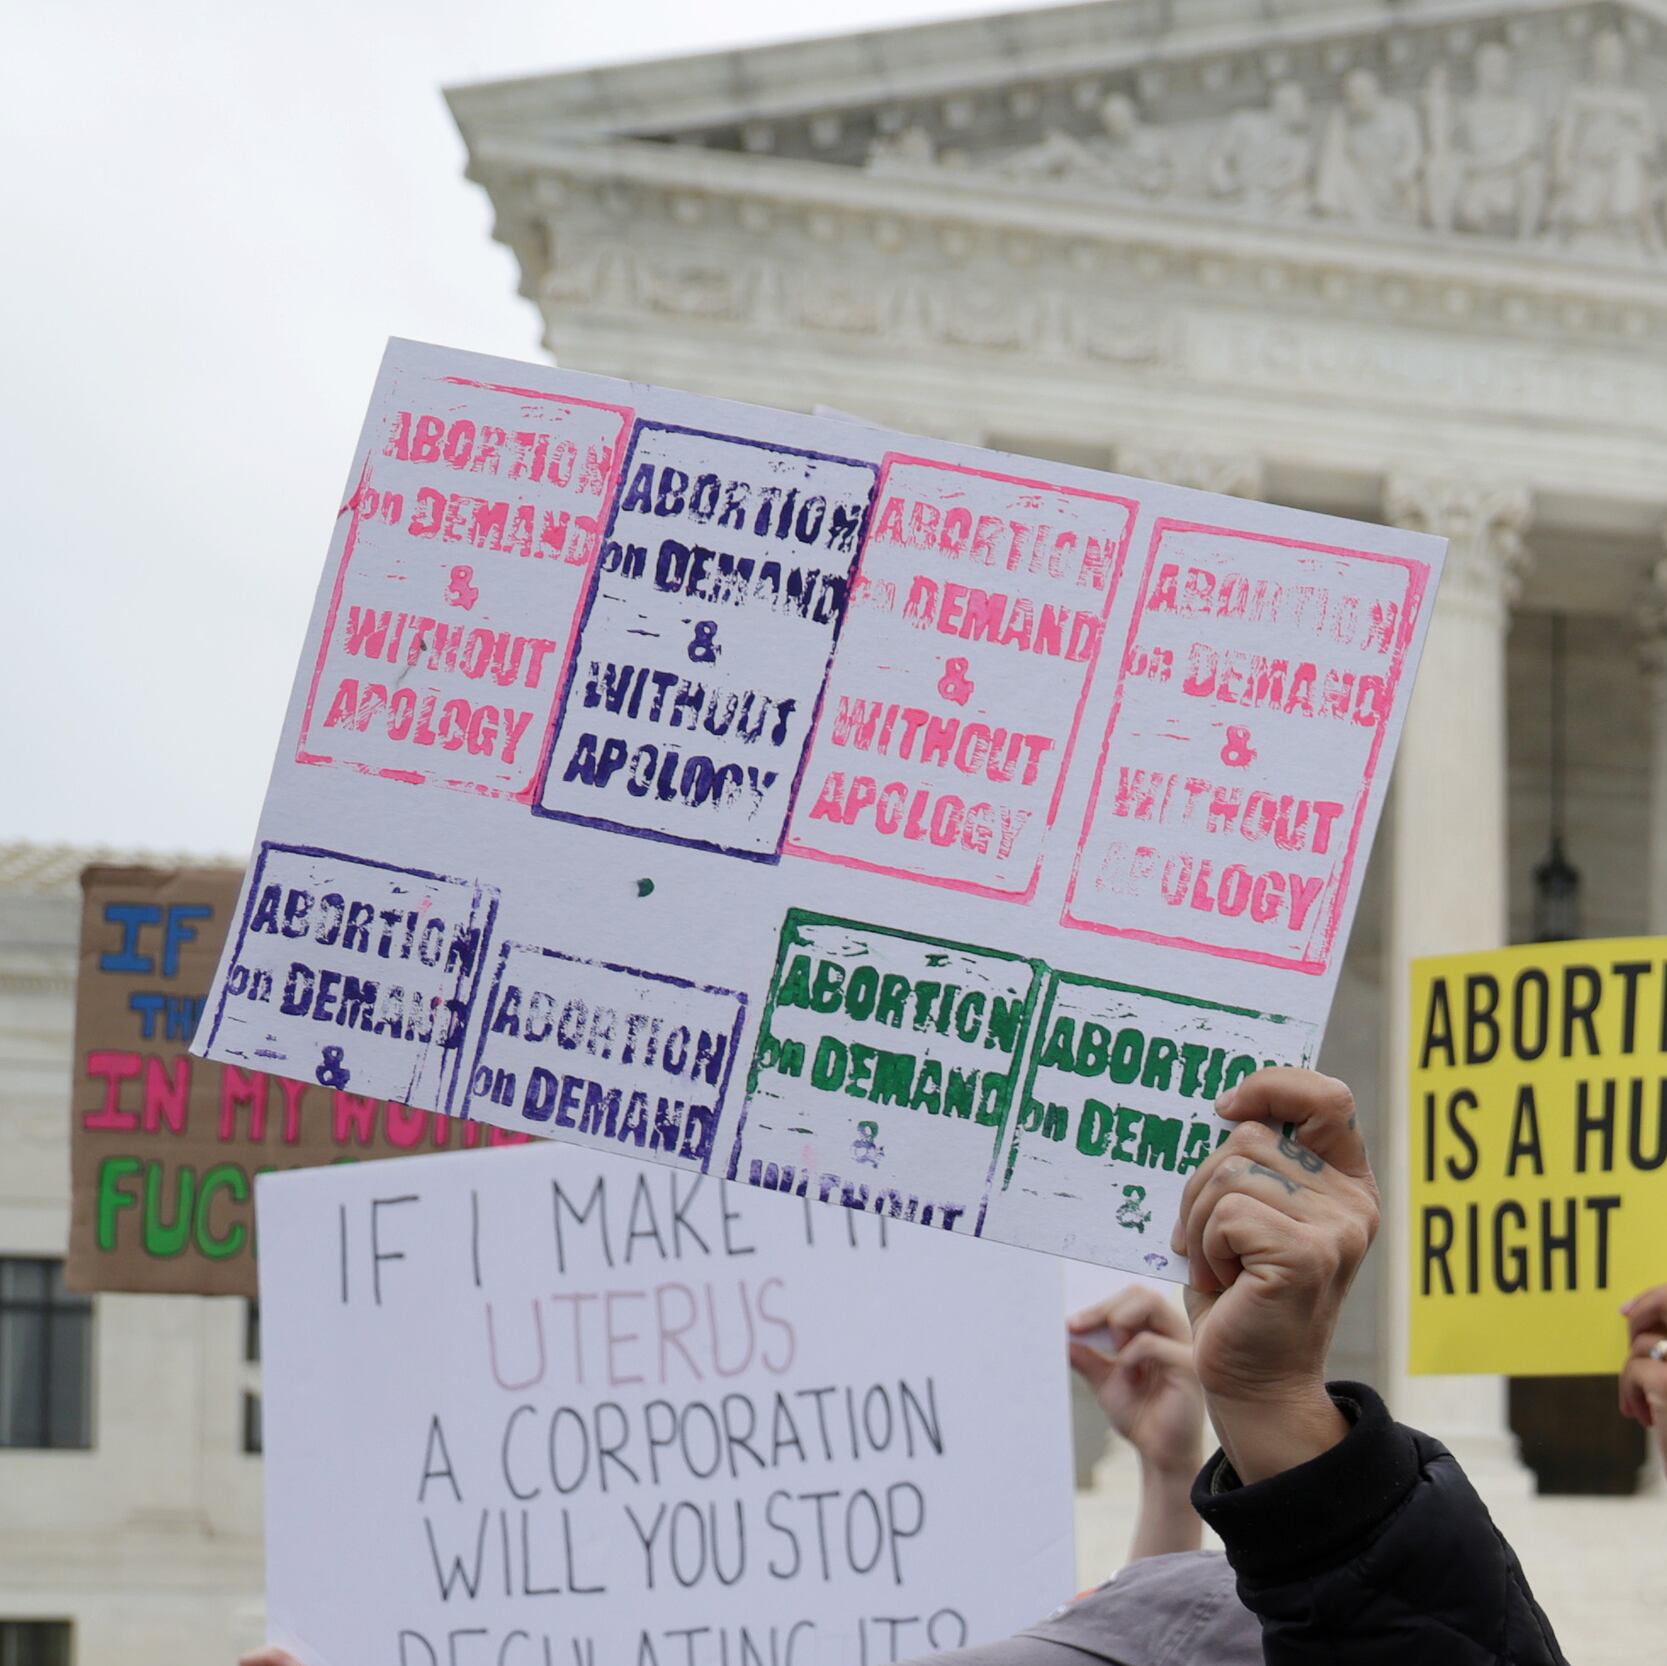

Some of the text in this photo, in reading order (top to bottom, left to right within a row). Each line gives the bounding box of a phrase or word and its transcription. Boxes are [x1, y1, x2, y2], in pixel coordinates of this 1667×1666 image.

[384, 412, 611, 494] ABORTION
[408, 486, 602, 568] DEMAND
[621, 464, 866, 554] ABORTION
[873, 497, 1116, 589] ABORTION
[444, 566, 479, 611] &
[653, 539, 853, 625] DEMAND
[903, 575, 1101, 662] DEMAND
[344, 605, 555, 690] WITHOUT
[686, 621, 721, 665] &
[937, 656, 974, 705] &
[1183, 642, 1388, 727] DEMAND
[323, 678, 534, 765] APOLOGY
[582, 661, 795, 746] WITHOUT
[833, 696, 1055, 787] WITHOUT
[1220, 724, 1257, 767] &
[563, 734, 778, 818] APOLOGY
[808, 772, 1032, 859] APOLOGY
[1113, 766, 1344, 854] WITHOUT
[101, 904, 213, 978] IF
[776, 954, 1021, 1053] ABORTION
[85, 1051, 190, 1134] IN
[521, 1066, 714, 1161] DEMAND
[811, 1036, 1007, 1127] DEMAND
[1077, 1099, 1232, 1175] DEMA
[1424, 1087, 1481, 1183] IS
[1506, 1083, 1545, 1179] A
[97, 1157, 257, 1260] FUC
[338, 1195, 421, 1306] IF
[552, 1173, 757, 1275] MAKE
[1420, 1194, 1621, 1298] RIGHT
[486, 1276, 797, 1392] UTERUS
[418, 1377, 945, 1504] A CORPORATION
[424, 1508, 606, 1602] WILL
